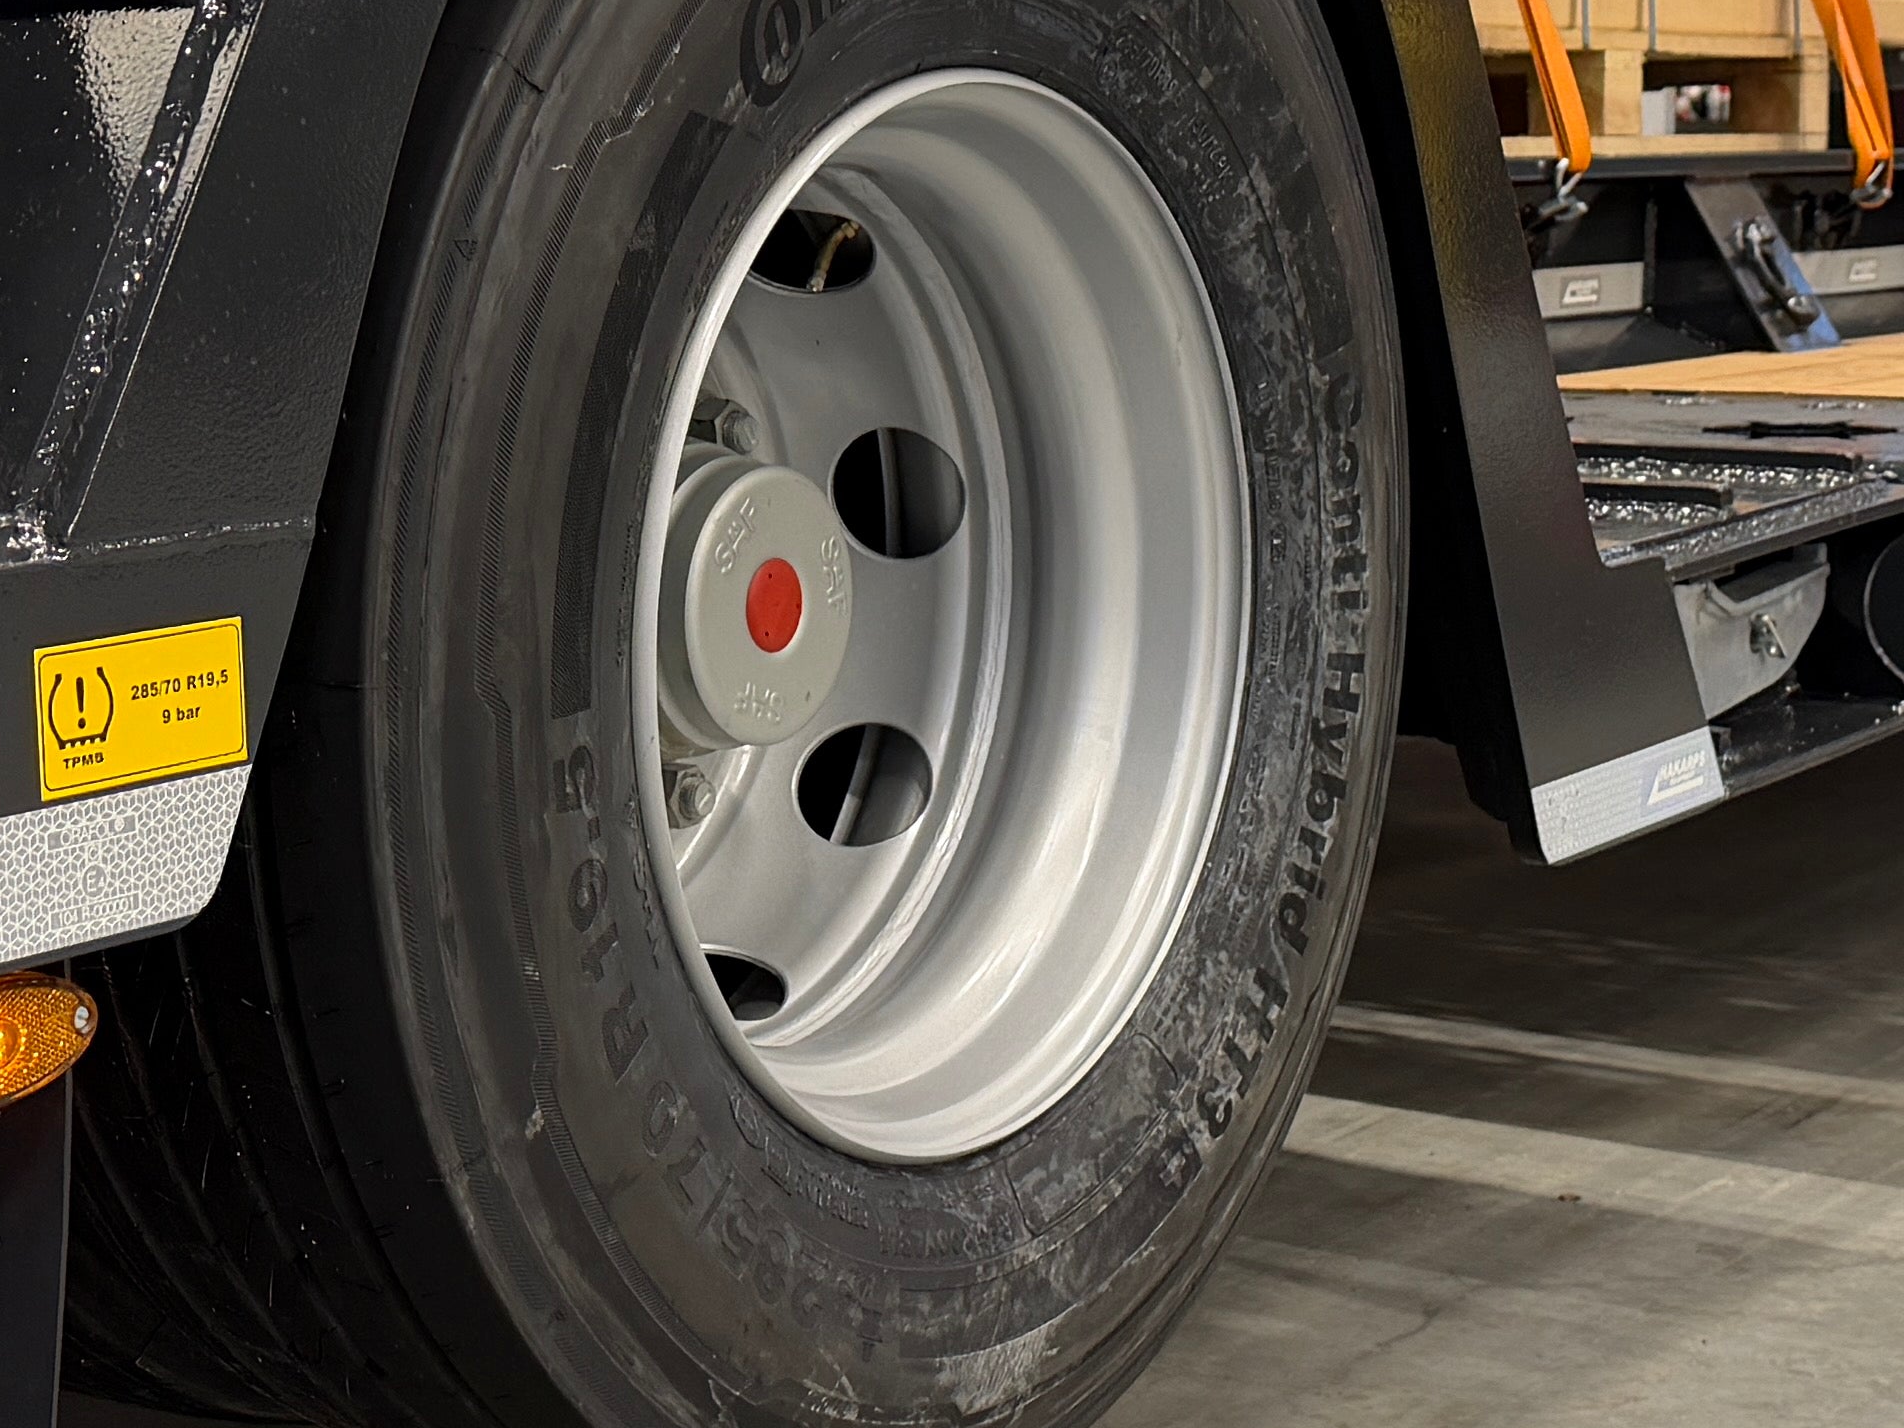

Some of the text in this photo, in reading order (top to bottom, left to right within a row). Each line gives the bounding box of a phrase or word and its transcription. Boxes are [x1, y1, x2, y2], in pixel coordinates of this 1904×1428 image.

[1325, 371, 1367, 610] Conti
[713, 496, 758, 575] SAF
[820, 535, 849, 617] SAF
[131, 669, 229, 701] 285/70 R19,5
[162, 705, 201, 723] 9 bar
[1276, 652, 1365, 956] Hybrid
